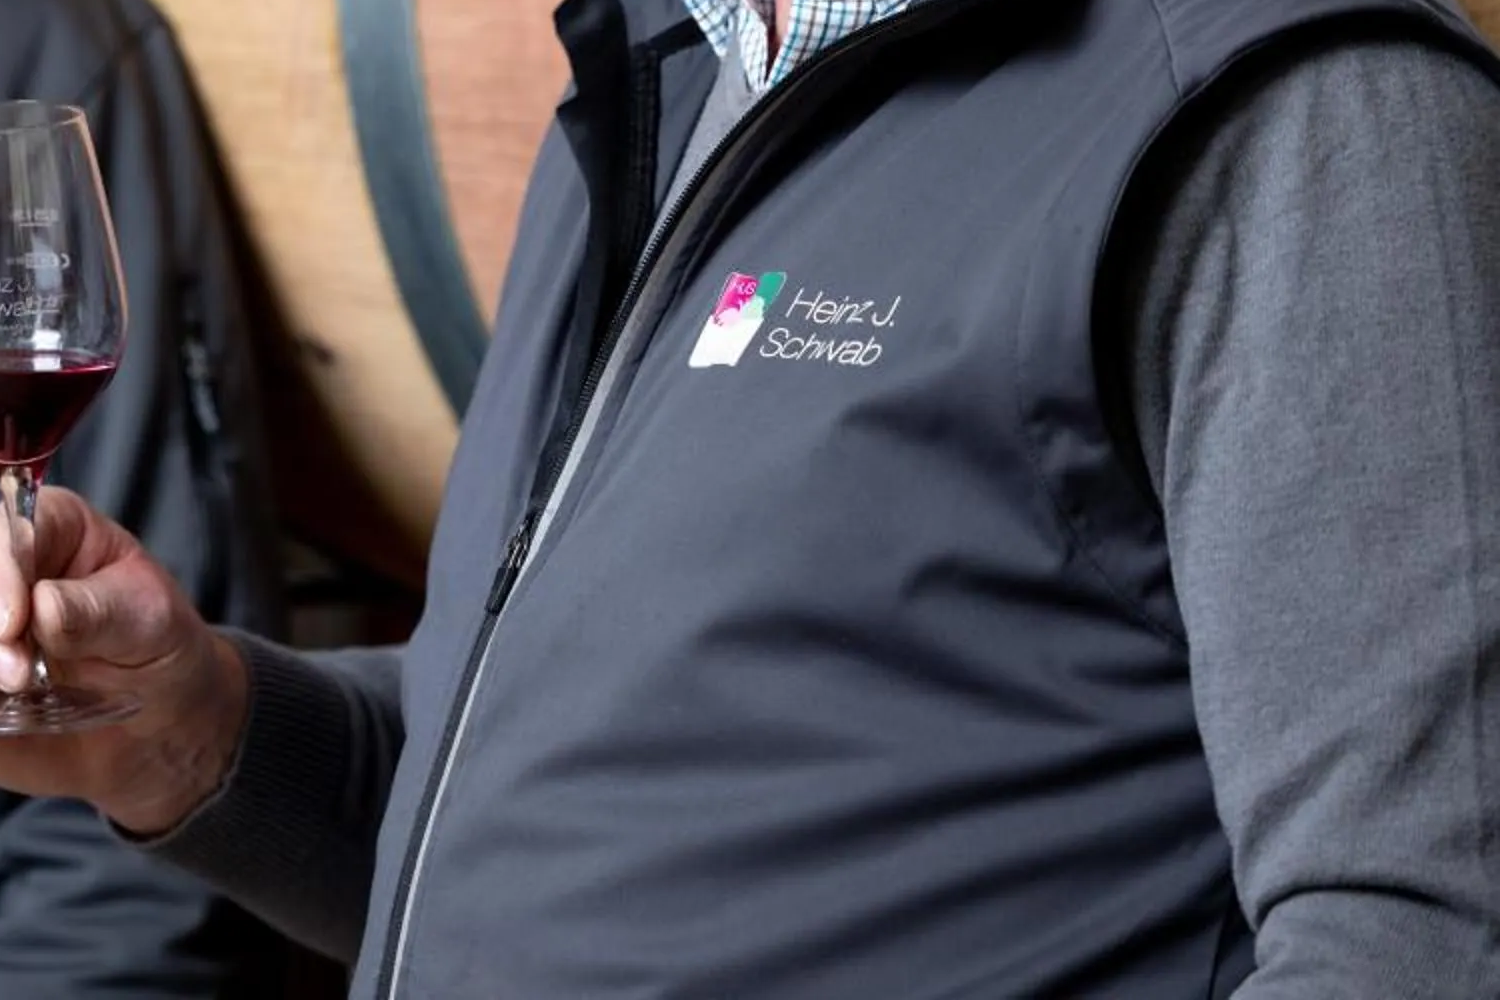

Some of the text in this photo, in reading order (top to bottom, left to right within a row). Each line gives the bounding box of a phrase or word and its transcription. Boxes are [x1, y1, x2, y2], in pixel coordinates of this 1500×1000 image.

[785, 287, 901, 328] Heinz J.
[759, 327, 883, 366] Schwab
